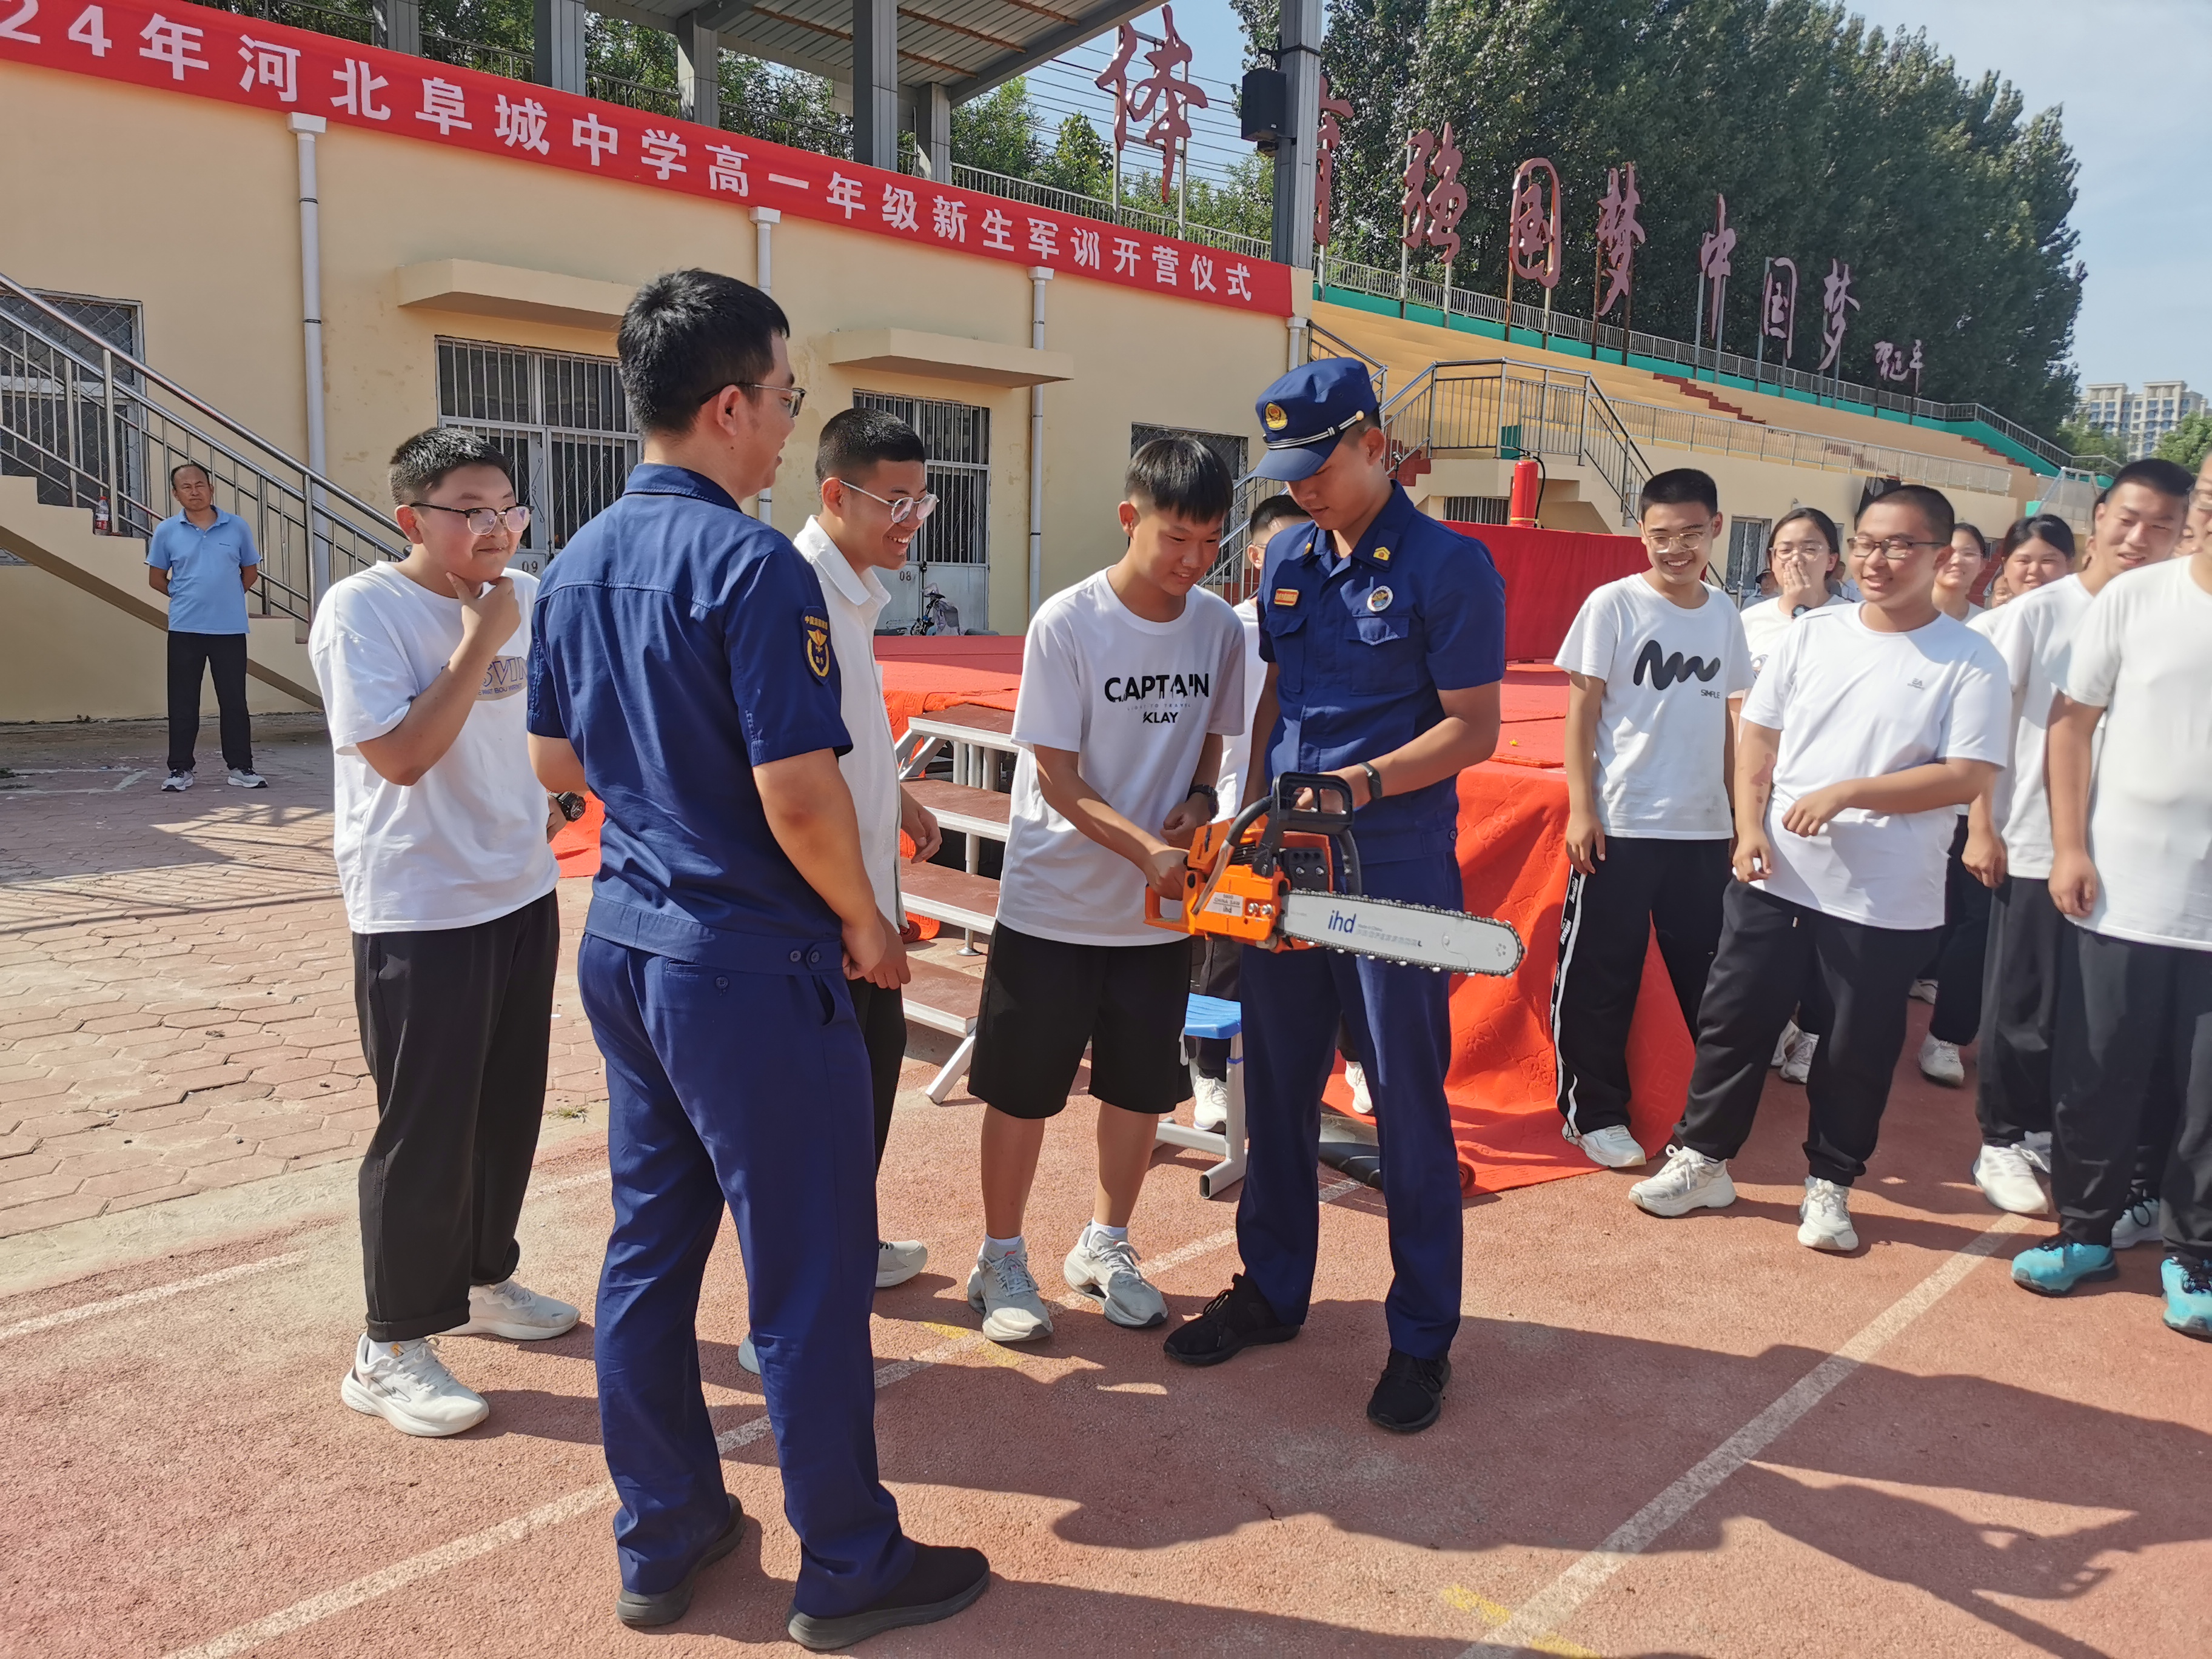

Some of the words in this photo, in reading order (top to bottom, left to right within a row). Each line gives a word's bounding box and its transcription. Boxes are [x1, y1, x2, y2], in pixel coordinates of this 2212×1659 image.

[522, 560, 538, 573] 09
[899, 571, 911, 581] 08
[1104, 673, 1209, 702] CAPTAIN
[1143, 711, 1178, 723] KLAY
[1328, 910, 1356, 933] ihd
